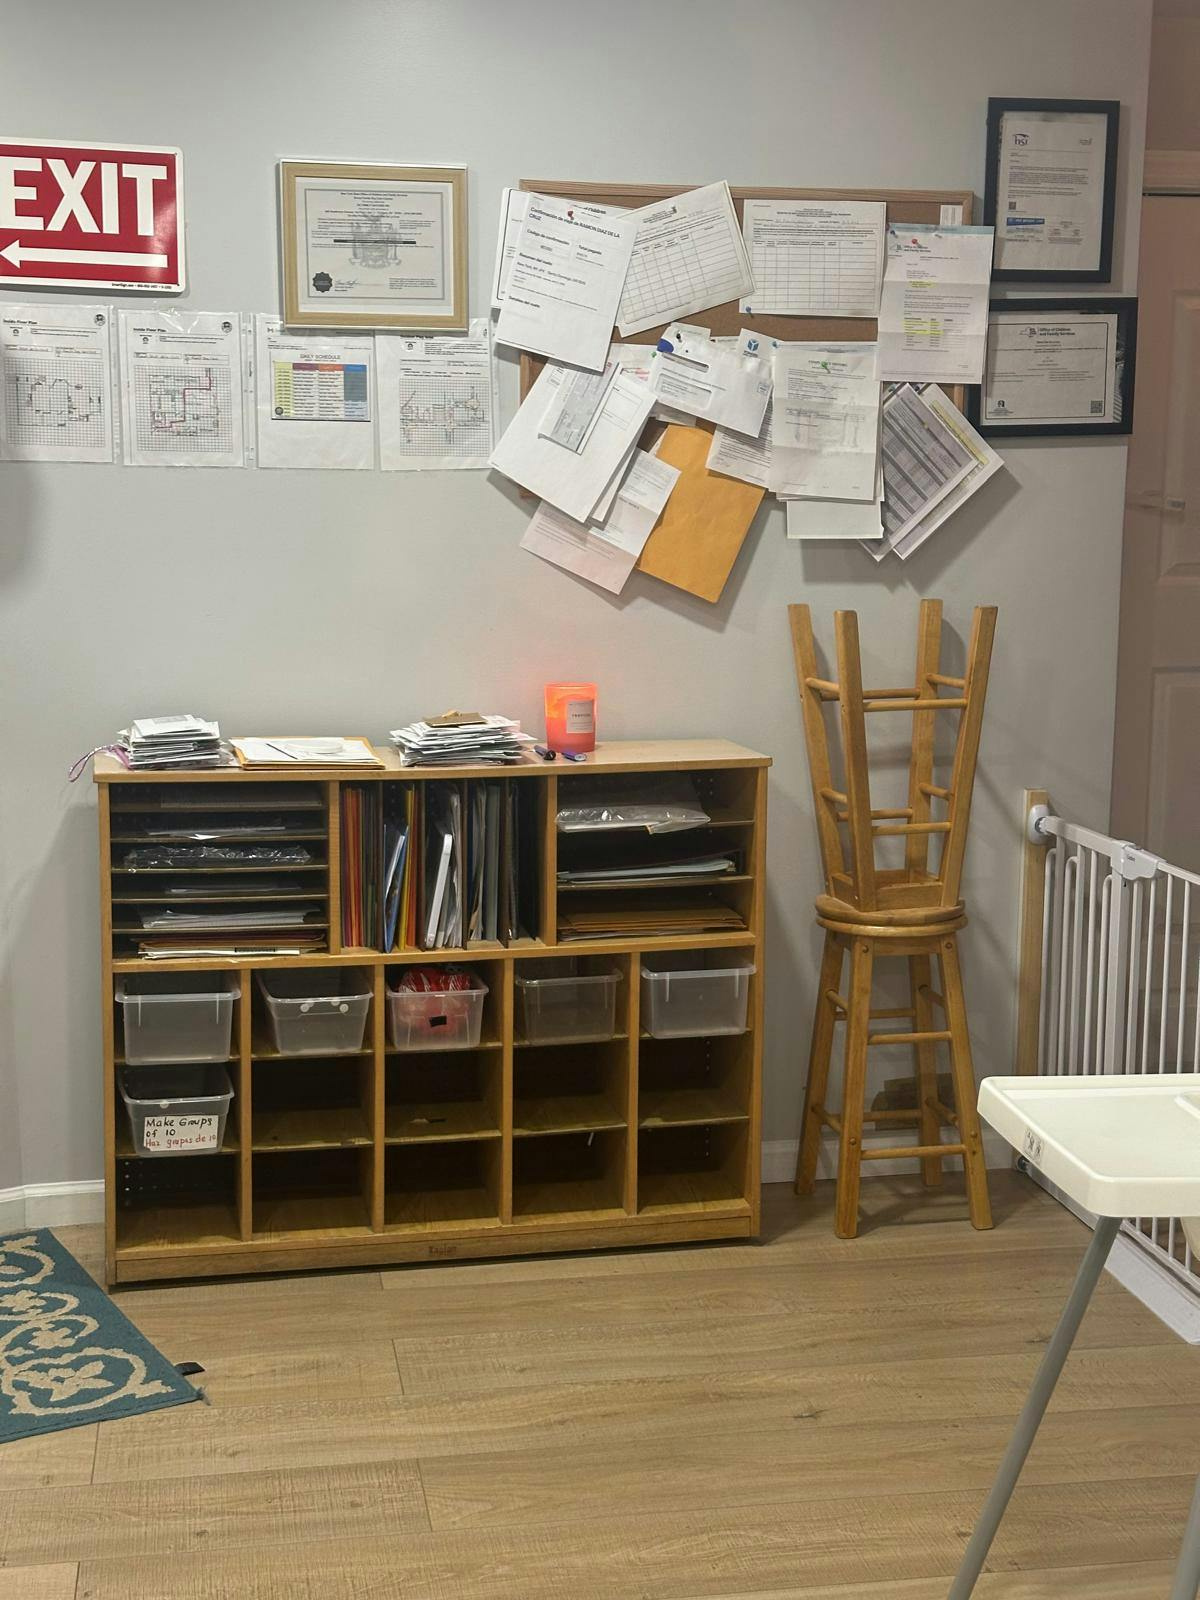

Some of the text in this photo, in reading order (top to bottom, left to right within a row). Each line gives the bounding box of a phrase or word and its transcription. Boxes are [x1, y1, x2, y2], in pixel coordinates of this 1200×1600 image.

[0, 155, 168, 237] EXIT
[146, 1116, 213, 1129] Make Groups
[146, 1128, 176, 1138] of 10
[195, 1133, 206, 1143] de
